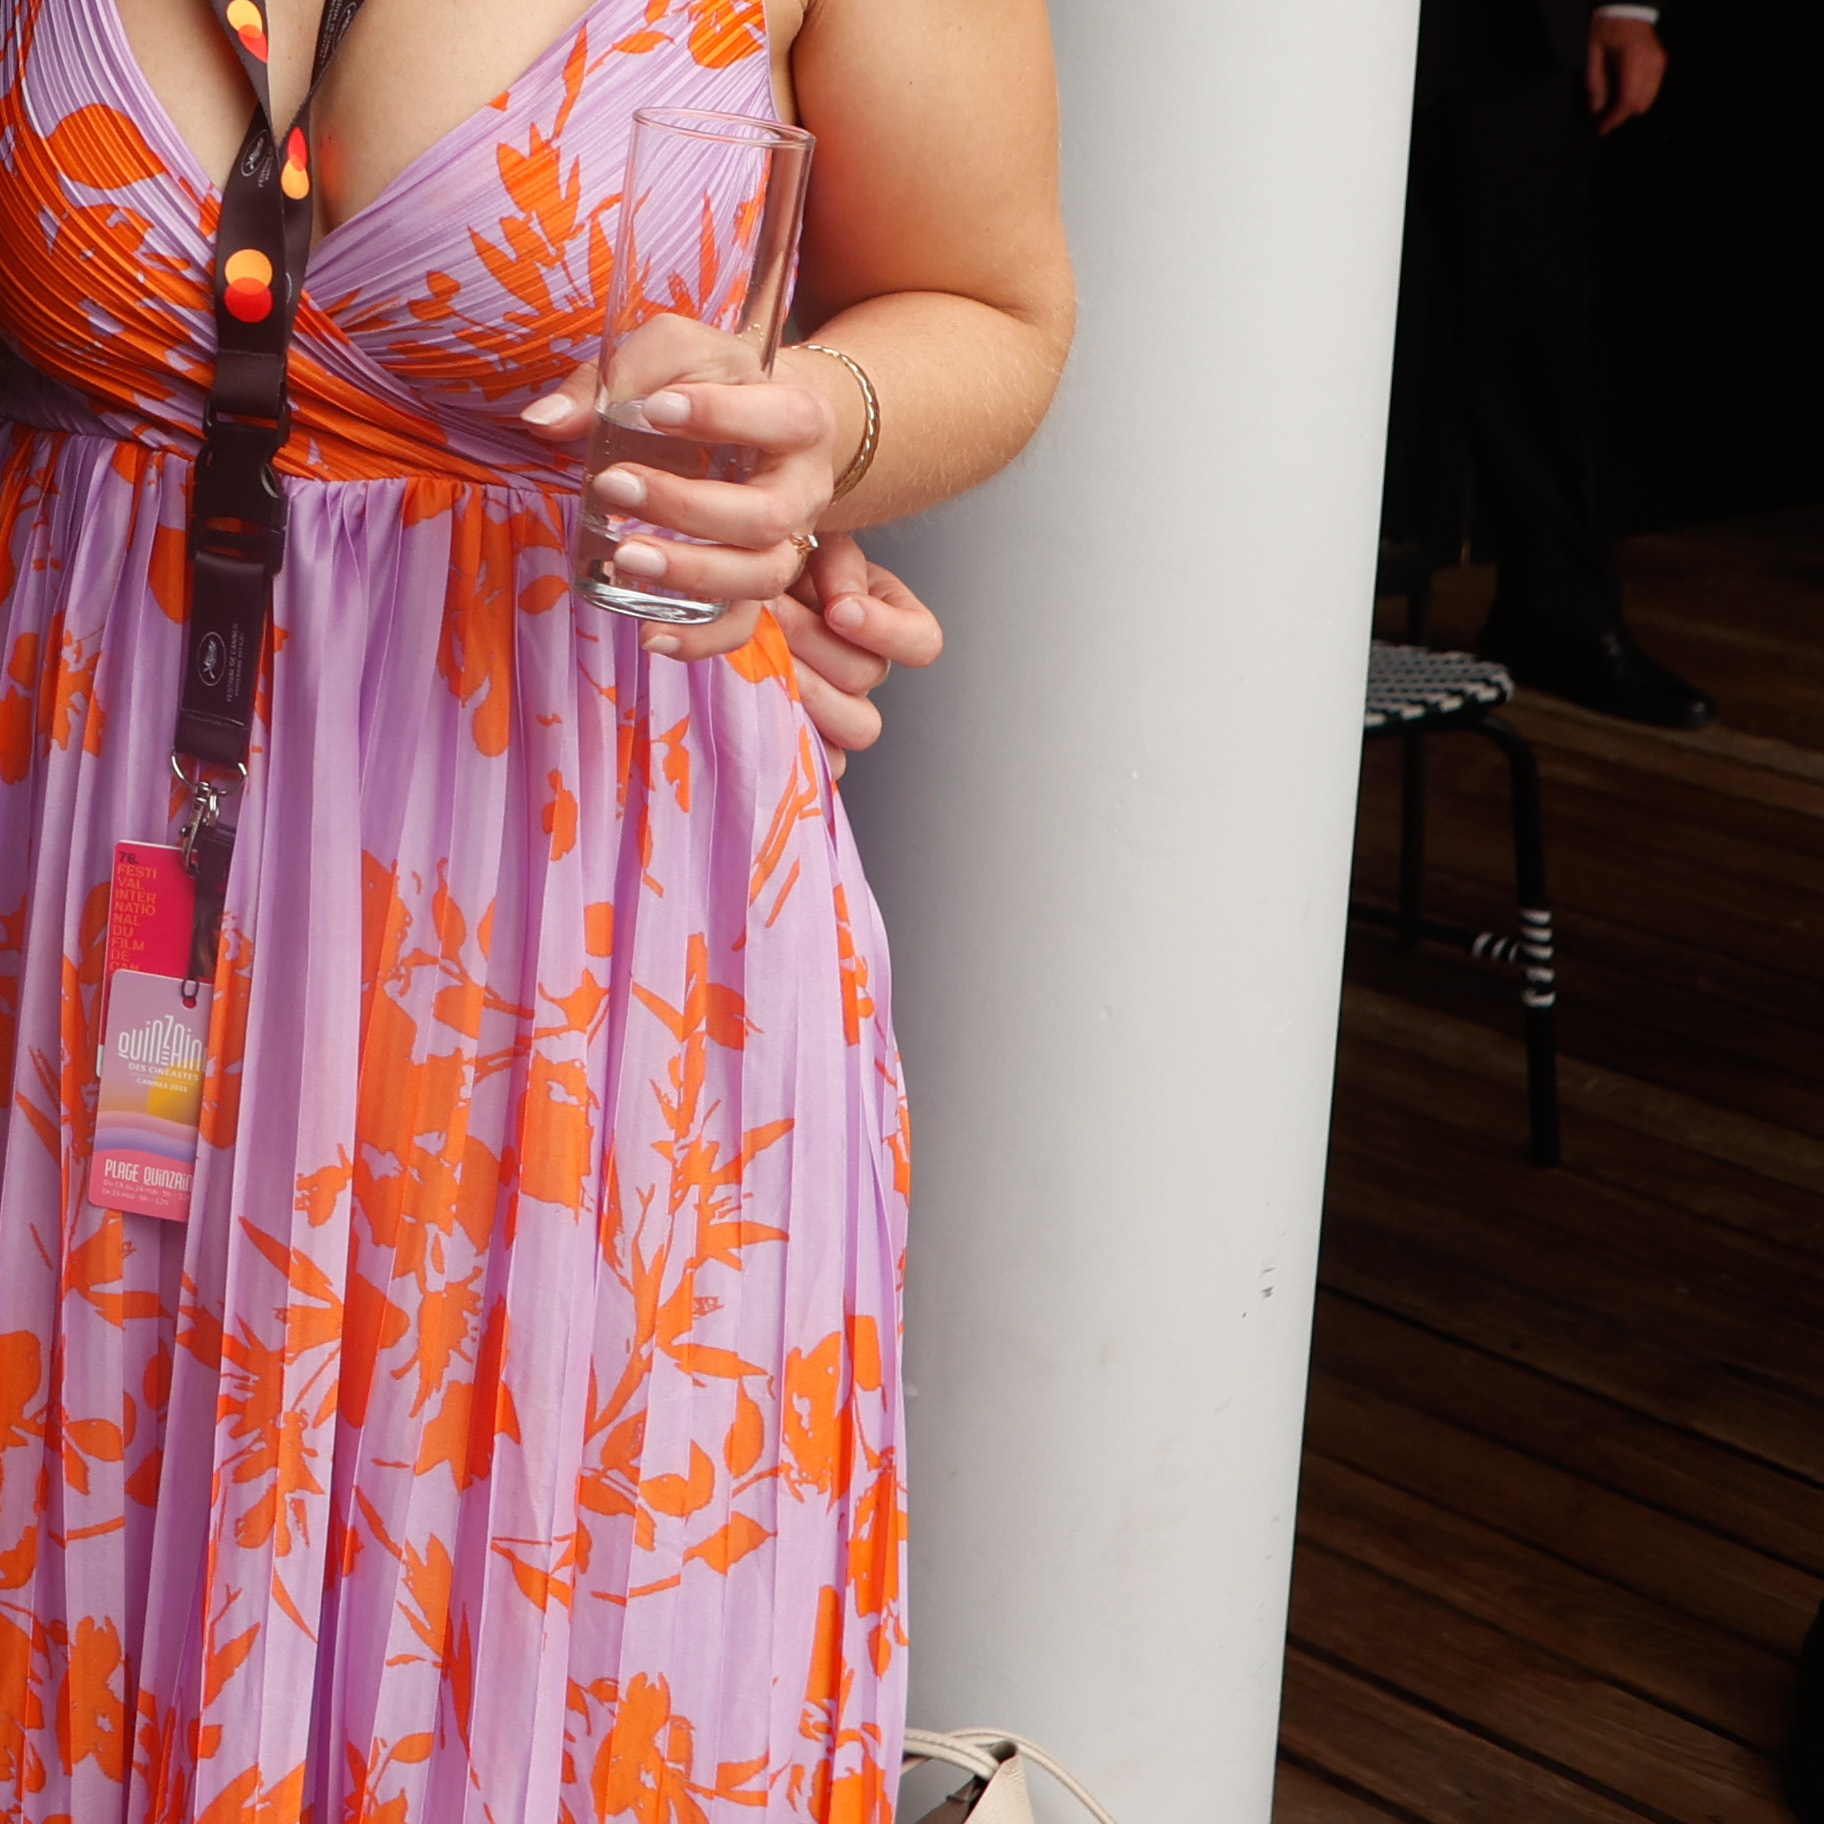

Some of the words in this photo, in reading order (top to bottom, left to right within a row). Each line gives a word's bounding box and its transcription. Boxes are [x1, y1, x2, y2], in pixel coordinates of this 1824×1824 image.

[117, 864, 157, 879] FESTI
[117, 877, 144, 890] VAL
[115, 889, 156, 904] INTER
[114, 901, 156, 916] NATIO
[113, 913, 140, 926] NAL
[112, 925, 133, 937] DU
[112, 937, 144, 952] FILM
[111, 950, 129, 962] DE
[128, 1063, 146, 1072] DES
[136, 1077, 168, 1089] CANNES
[104, 1158, 140, 1182] PLAGE
